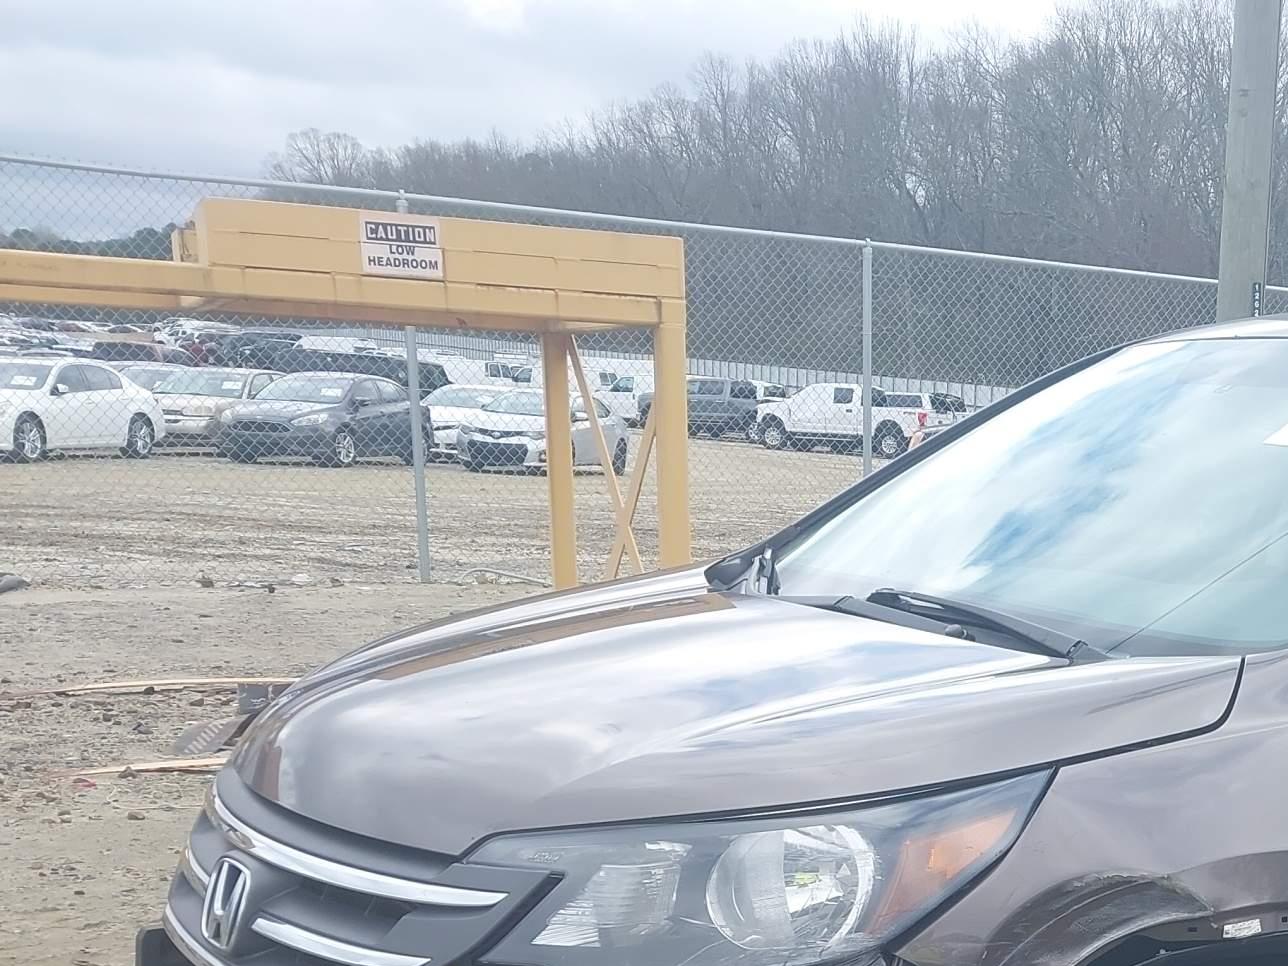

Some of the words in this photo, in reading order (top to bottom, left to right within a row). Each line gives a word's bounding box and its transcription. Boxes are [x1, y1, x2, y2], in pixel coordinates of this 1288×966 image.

[366, 223, 435, 243] CAUTION
[388, 244, 416, 256] LOW
[367, 255, 439, 271] HEADROOM
